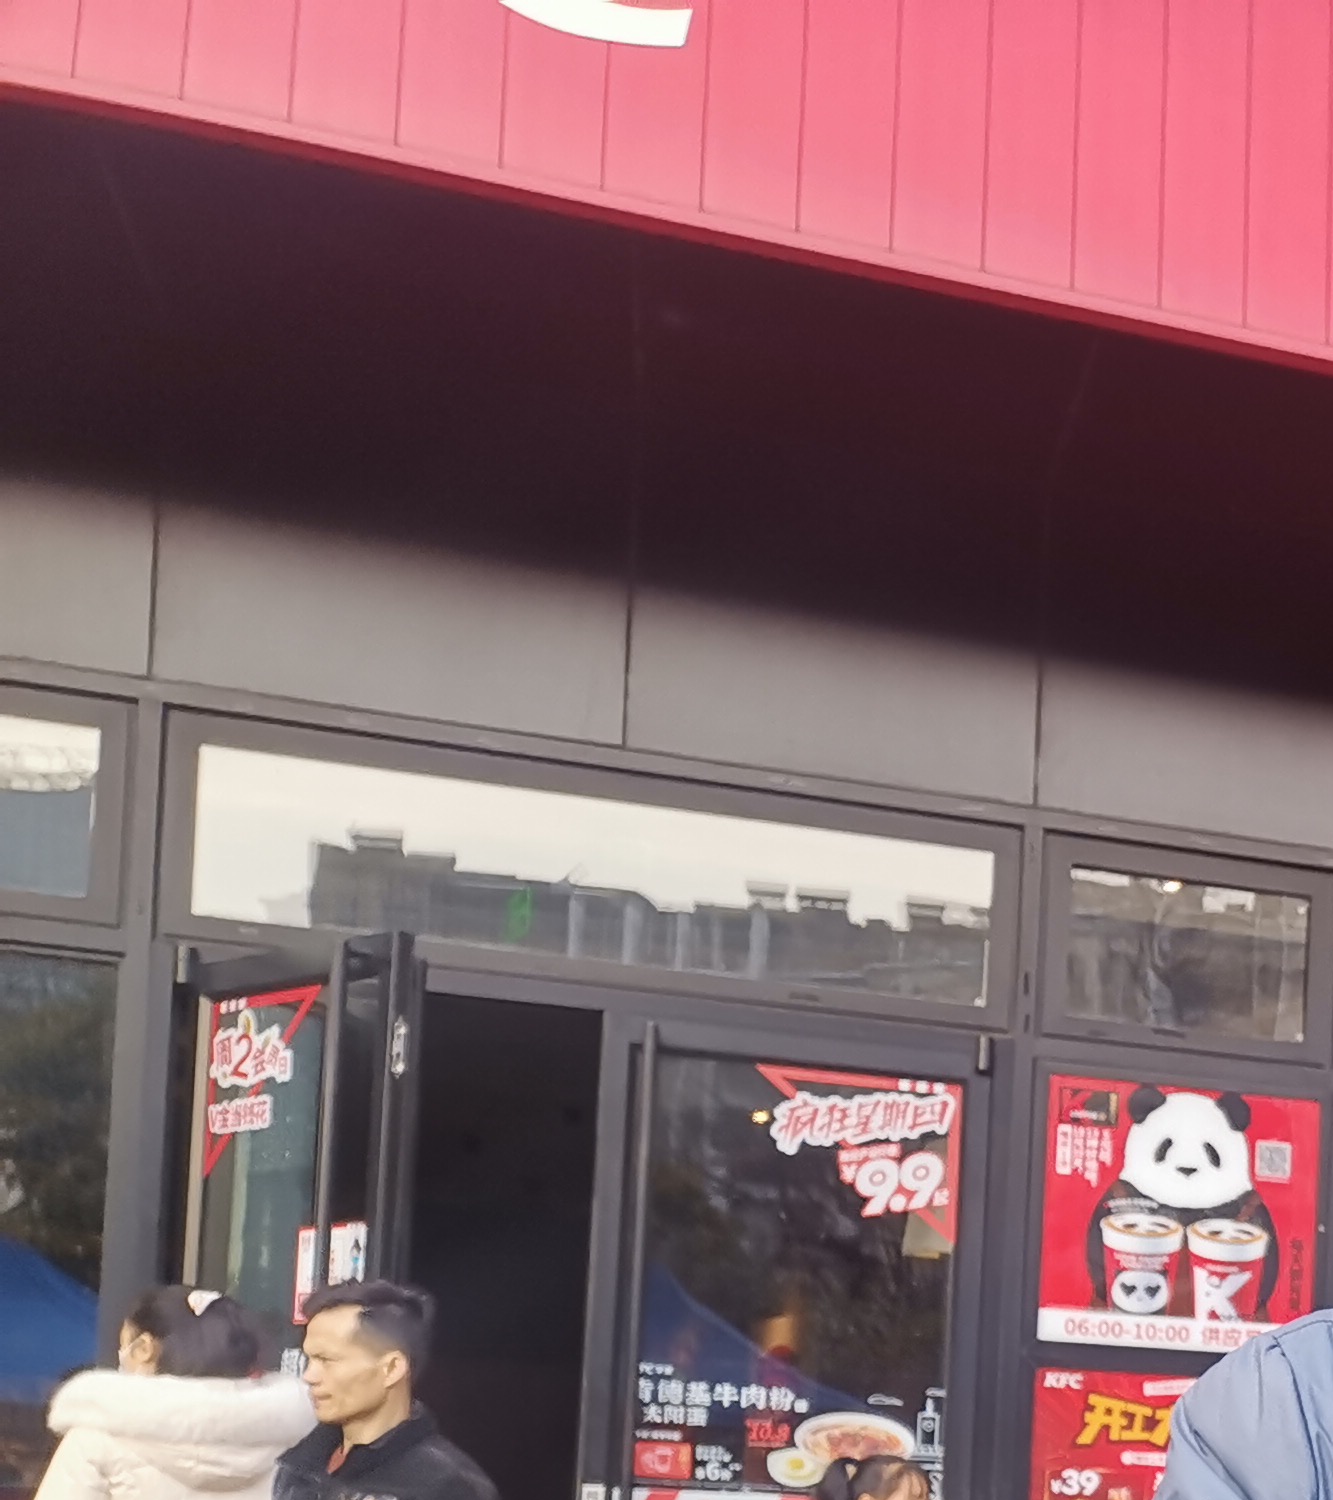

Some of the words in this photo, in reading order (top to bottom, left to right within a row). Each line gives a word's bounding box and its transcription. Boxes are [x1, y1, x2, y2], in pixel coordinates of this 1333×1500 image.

[1063, 1317, 1191, 1344] 06:00-10:00
[1043, 1371, 1085, 1391] KFC
[1050, 1467, 1102, 1497] ¥39
